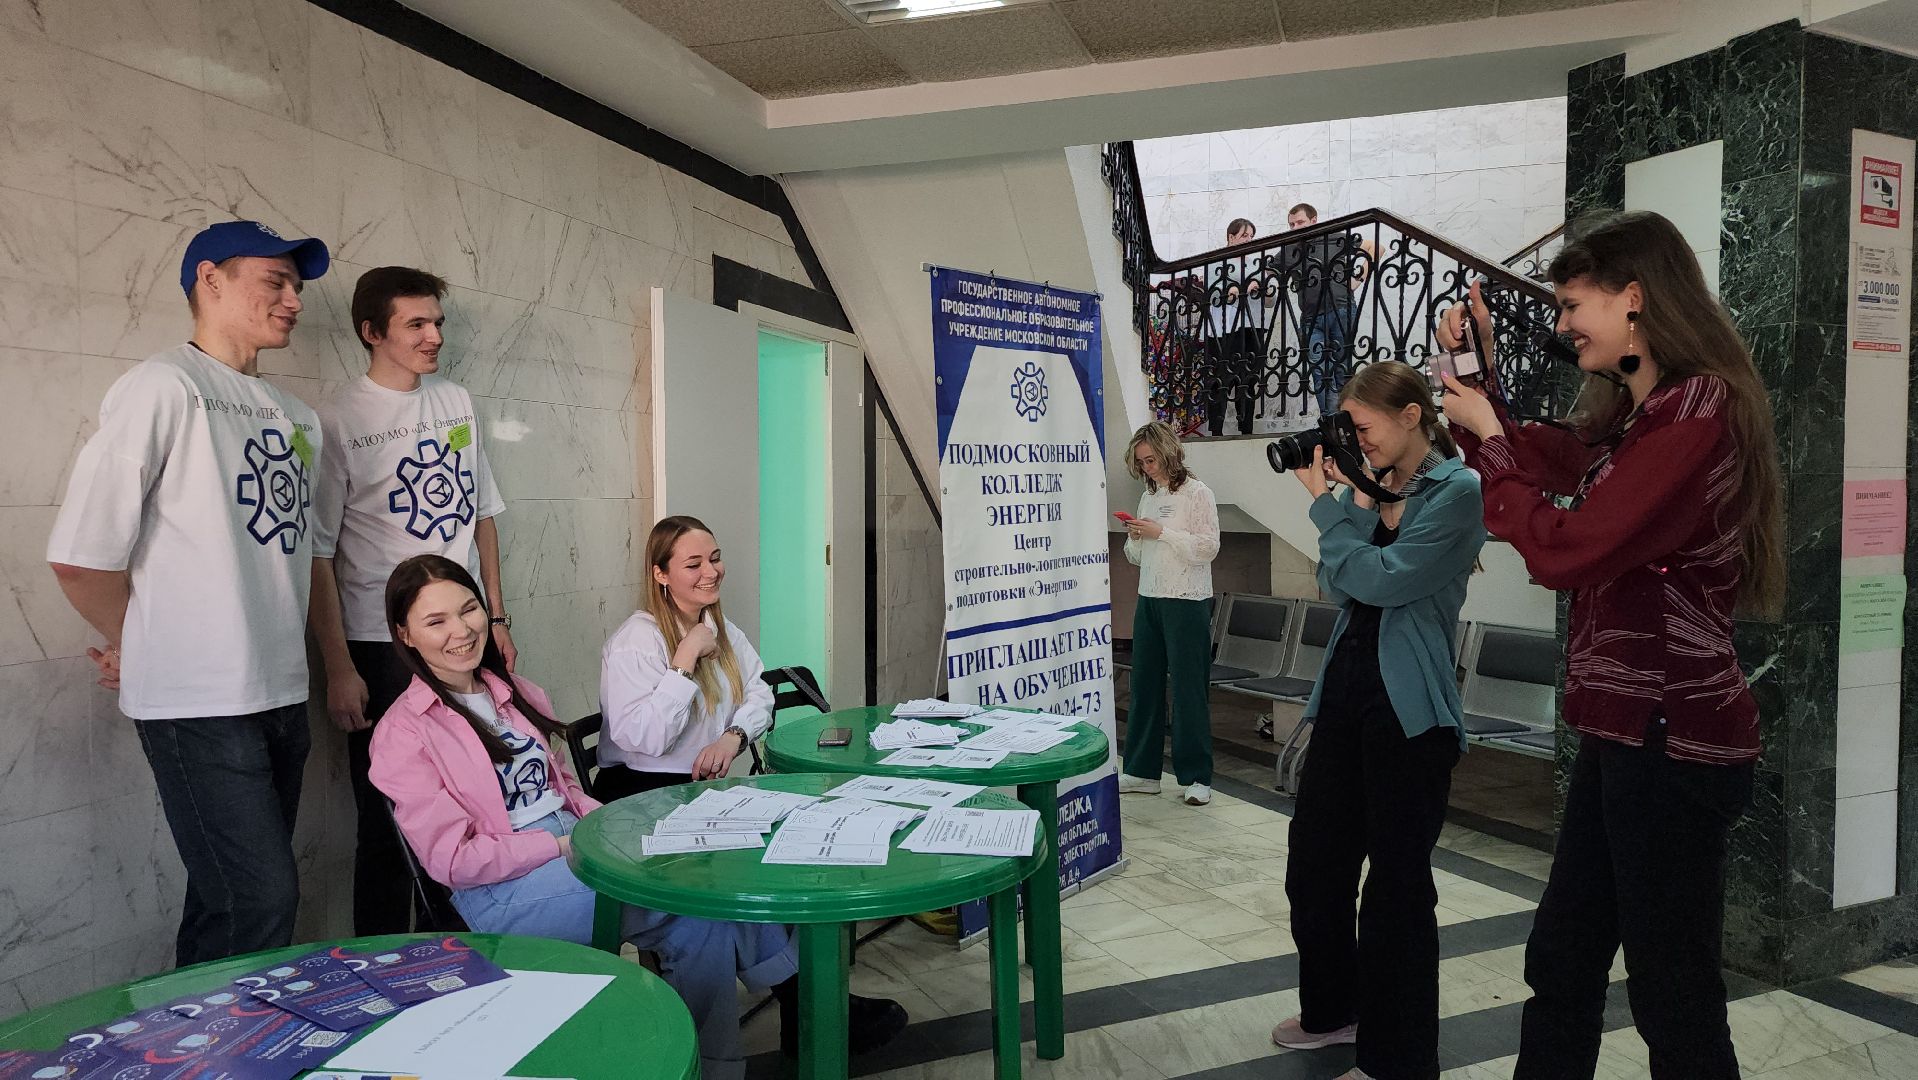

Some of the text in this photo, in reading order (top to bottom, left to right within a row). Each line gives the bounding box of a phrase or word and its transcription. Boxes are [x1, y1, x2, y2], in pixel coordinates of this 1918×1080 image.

[958, 279, 1081, 312] ГОСУДАРСТВЕННОЕ АВТОНОМНОЕ
[941, 298, 1094, 333] ПРОФЕССИОНАЛЬНОЕ ОБРАЗОВАТЕЛЬНОЕ
[949, 321, 1088, 351] УЧРЕЖДЕНИЕ МОСКОВСКОЙ ОБЛАСТИ
[232, 402, 252, 418] МО
[388, 426, 409, 442] МО
[948, 439, 1091, 467] ПОДМОСКОВНЫЙ
[981, 473, 1063, 495] КОЛЛЕДЖ
[986, 502, 1062, 527] ЭНЕРГИЯ
[1013, 533, 1052, 552] Центр
[954, 549, 1109, 585] строительно-логистической
[956, 578, 1078, 609] подготовки «Энергия»
[947, 623, 1112, 680] ПРИГЛАШАЕТ ВАС
[977, 657, 1107, 706] НА ОБУЧЕНИЕ
[1057, 795, 1093, 827] ЛЕДЖА
